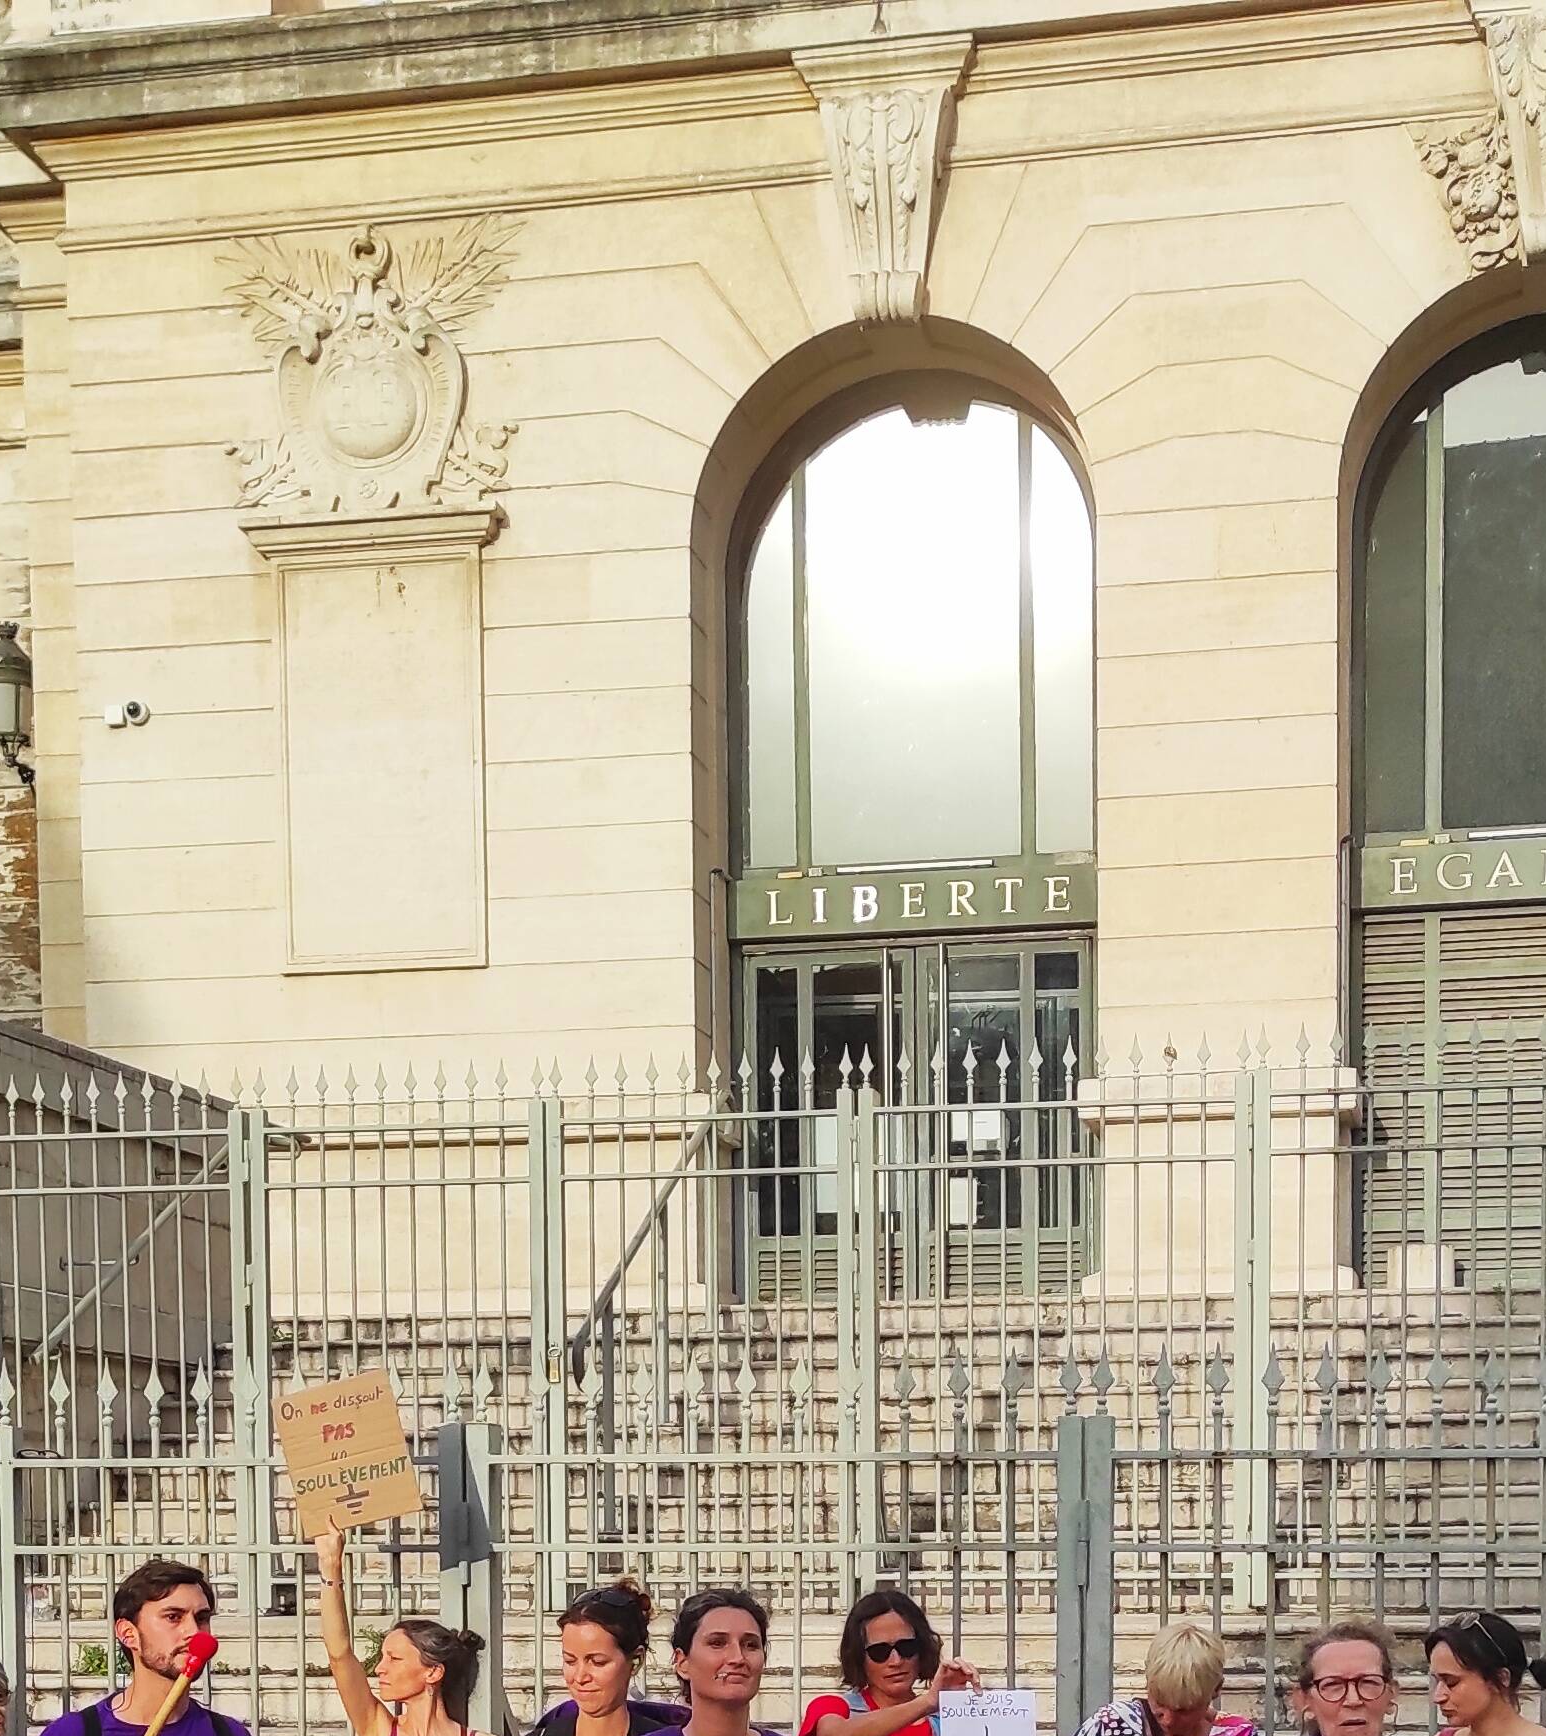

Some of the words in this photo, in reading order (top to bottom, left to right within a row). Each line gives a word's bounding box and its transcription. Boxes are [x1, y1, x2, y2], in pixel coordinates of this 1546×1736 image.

[765, 876, 1072, 926] LIBERTE
[281, 1402, 303, 1421] On
[310, 1401, 328, 1415] ne
[321, 1422, 356, 1443] PAS
[331, 1449, 348, 1461] un
[296, 1455, 408, 1496] SOULÈVEMENT
[985, 1693, 1014, 1706] SUIS
